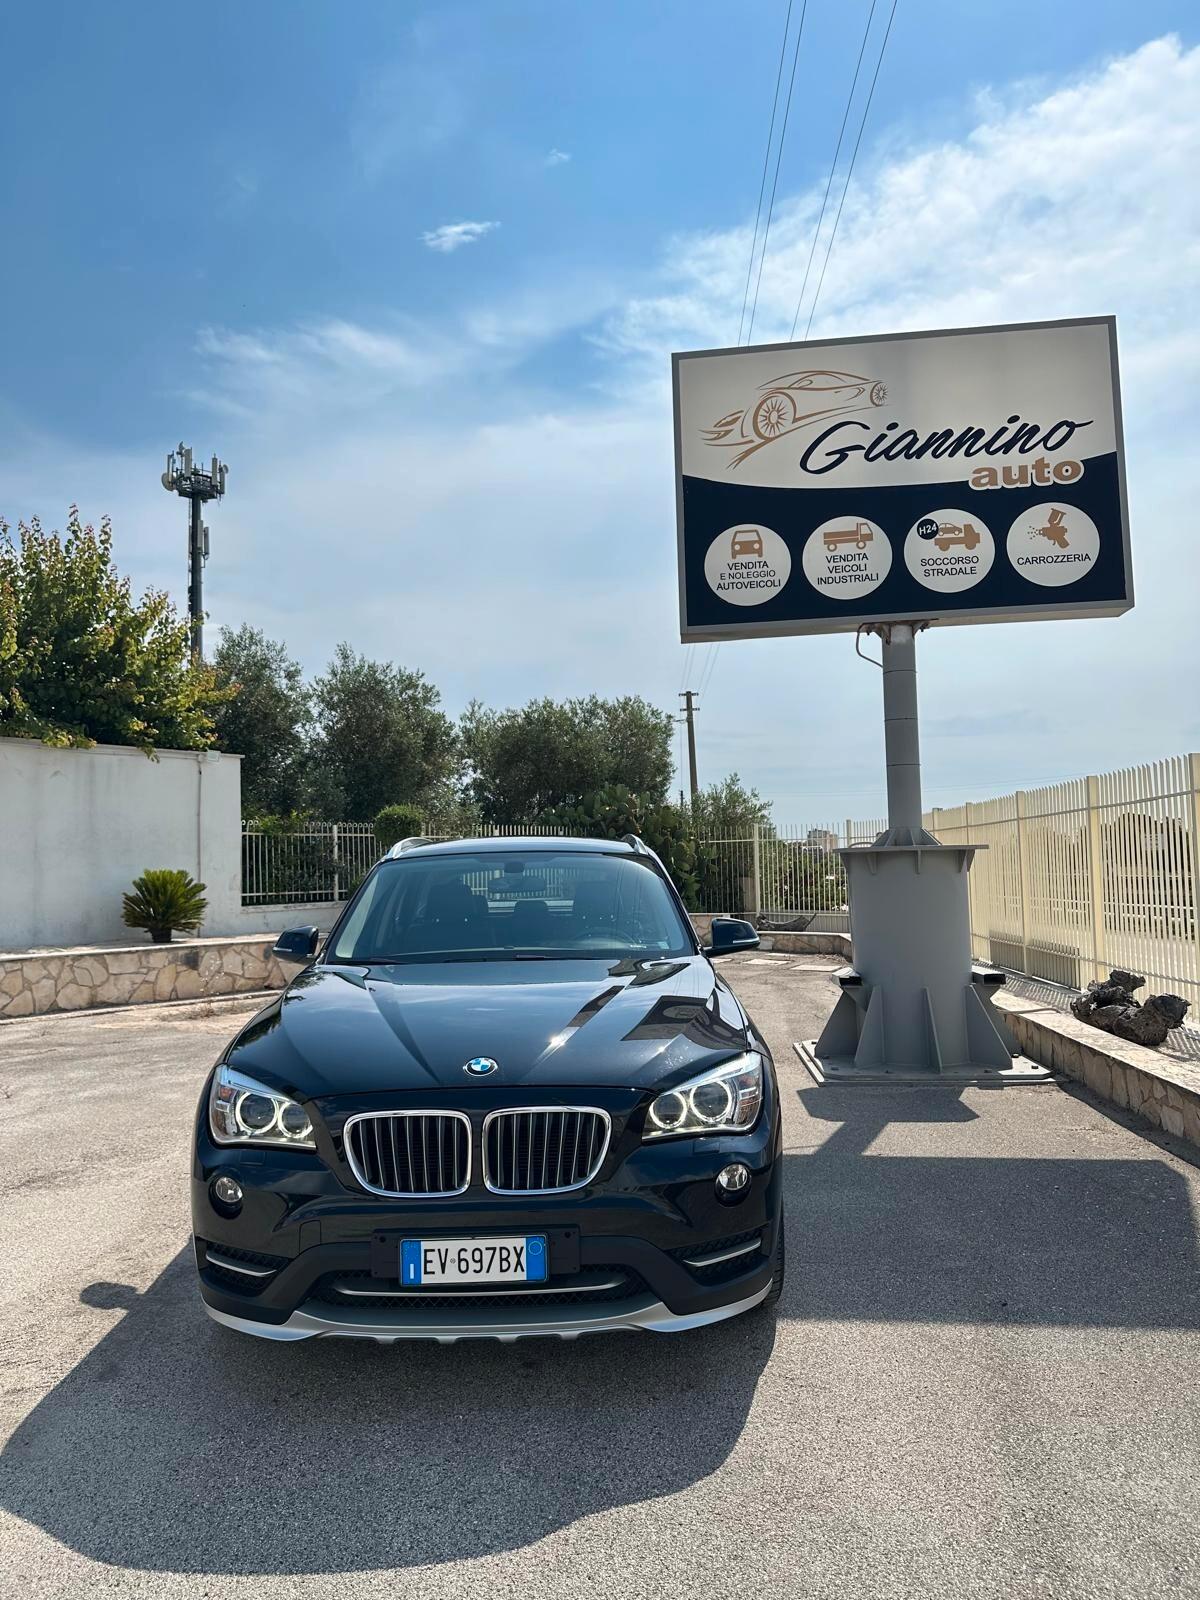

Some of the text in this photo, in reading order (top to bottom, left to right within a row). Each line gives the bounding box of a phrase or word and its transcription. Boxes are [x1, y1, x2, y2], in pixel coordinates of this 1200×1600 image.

[799, 414, 1094, 475] Giannino
[970, 456, 1083, 488] auto
[918, 522, 938, 536] H24
[825, 552, 869, 564] VENDITA
[920, 555, 979, 567] SOCCORSO
[1016, 553, 1092, 566] CARROZZERIA
[727, 560, 769, 571] VENDITA
[827, 563, 867, 574] VEICOLI
[923, 566, 977, 577] STRADALE
[719, 569, 776, 581] E NOLEGGIO
[817, 573, 879, 586] INDUSTRIALI
[716, 579, 781, 591] AUTOVEICOLI
